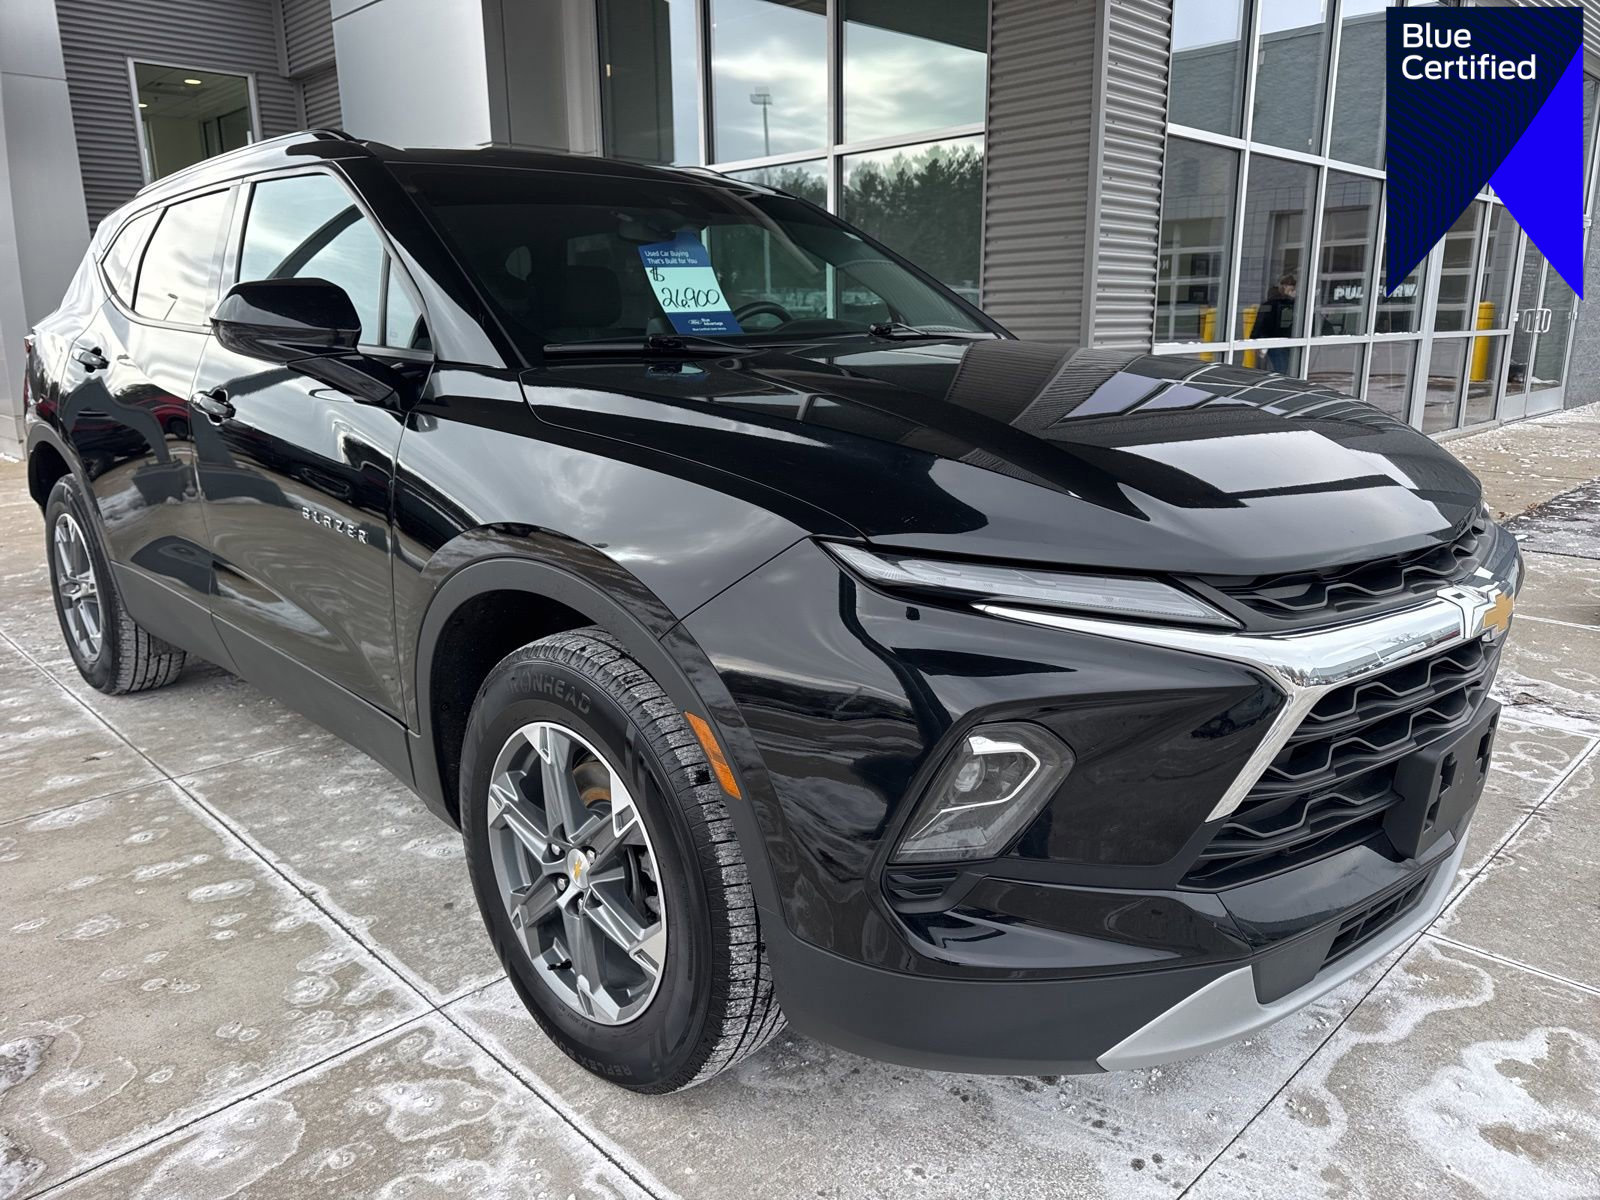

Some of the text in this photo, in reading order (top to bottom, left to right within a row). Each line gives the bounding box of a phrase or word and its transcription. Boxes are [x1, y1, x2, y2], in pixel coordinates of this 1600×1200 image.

[670, 250, 689, 258] Buying
[1333, 285, 1364, 300] PUL
[302, 506, 368, 545] BLAZER
[504, 671, 592, 714] RONHEAD
